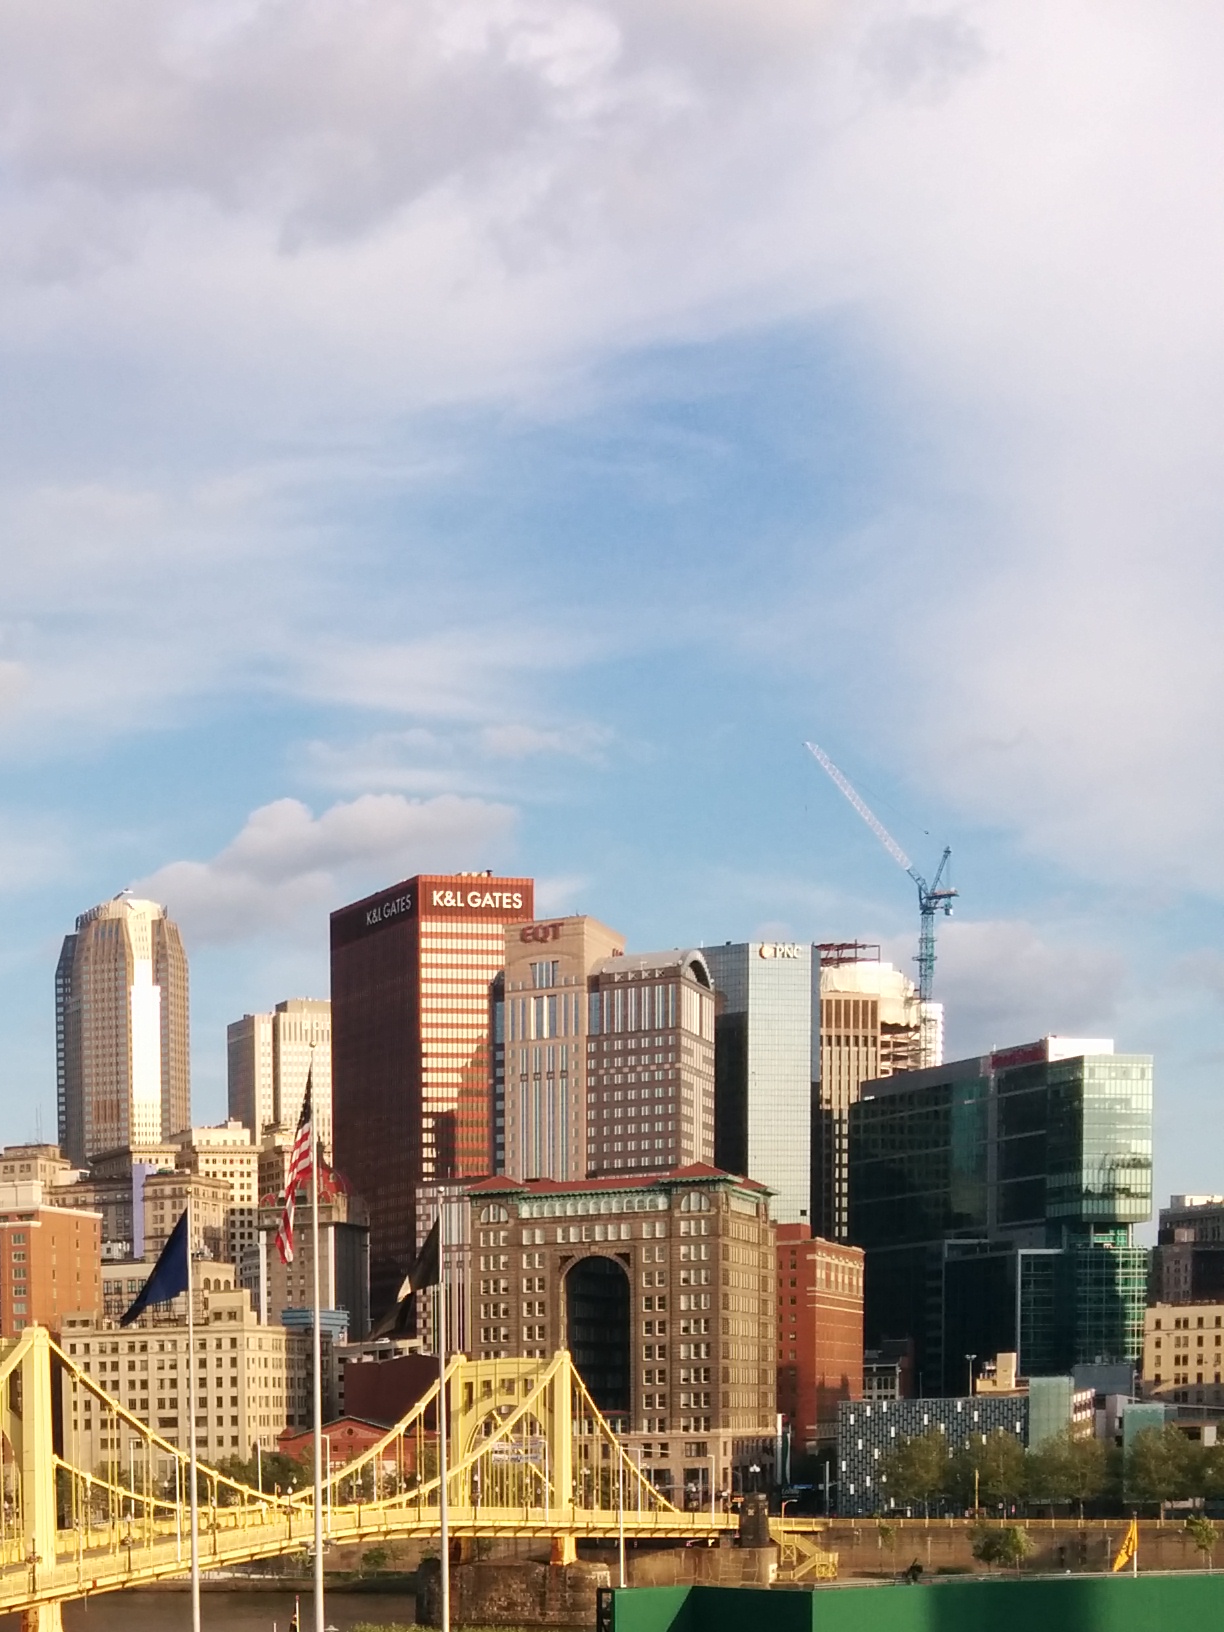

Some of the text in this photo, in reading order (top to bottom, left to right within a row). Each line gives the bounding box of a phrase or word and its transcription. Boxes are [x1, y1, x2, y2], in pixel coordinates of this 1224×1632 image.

[432, 890, 522, 909] K&L GATES
[366, 894, 412, 926] K&L GATES
[520, 923, 564, 943] EQT
[776, 945, 801, 958] PNC
